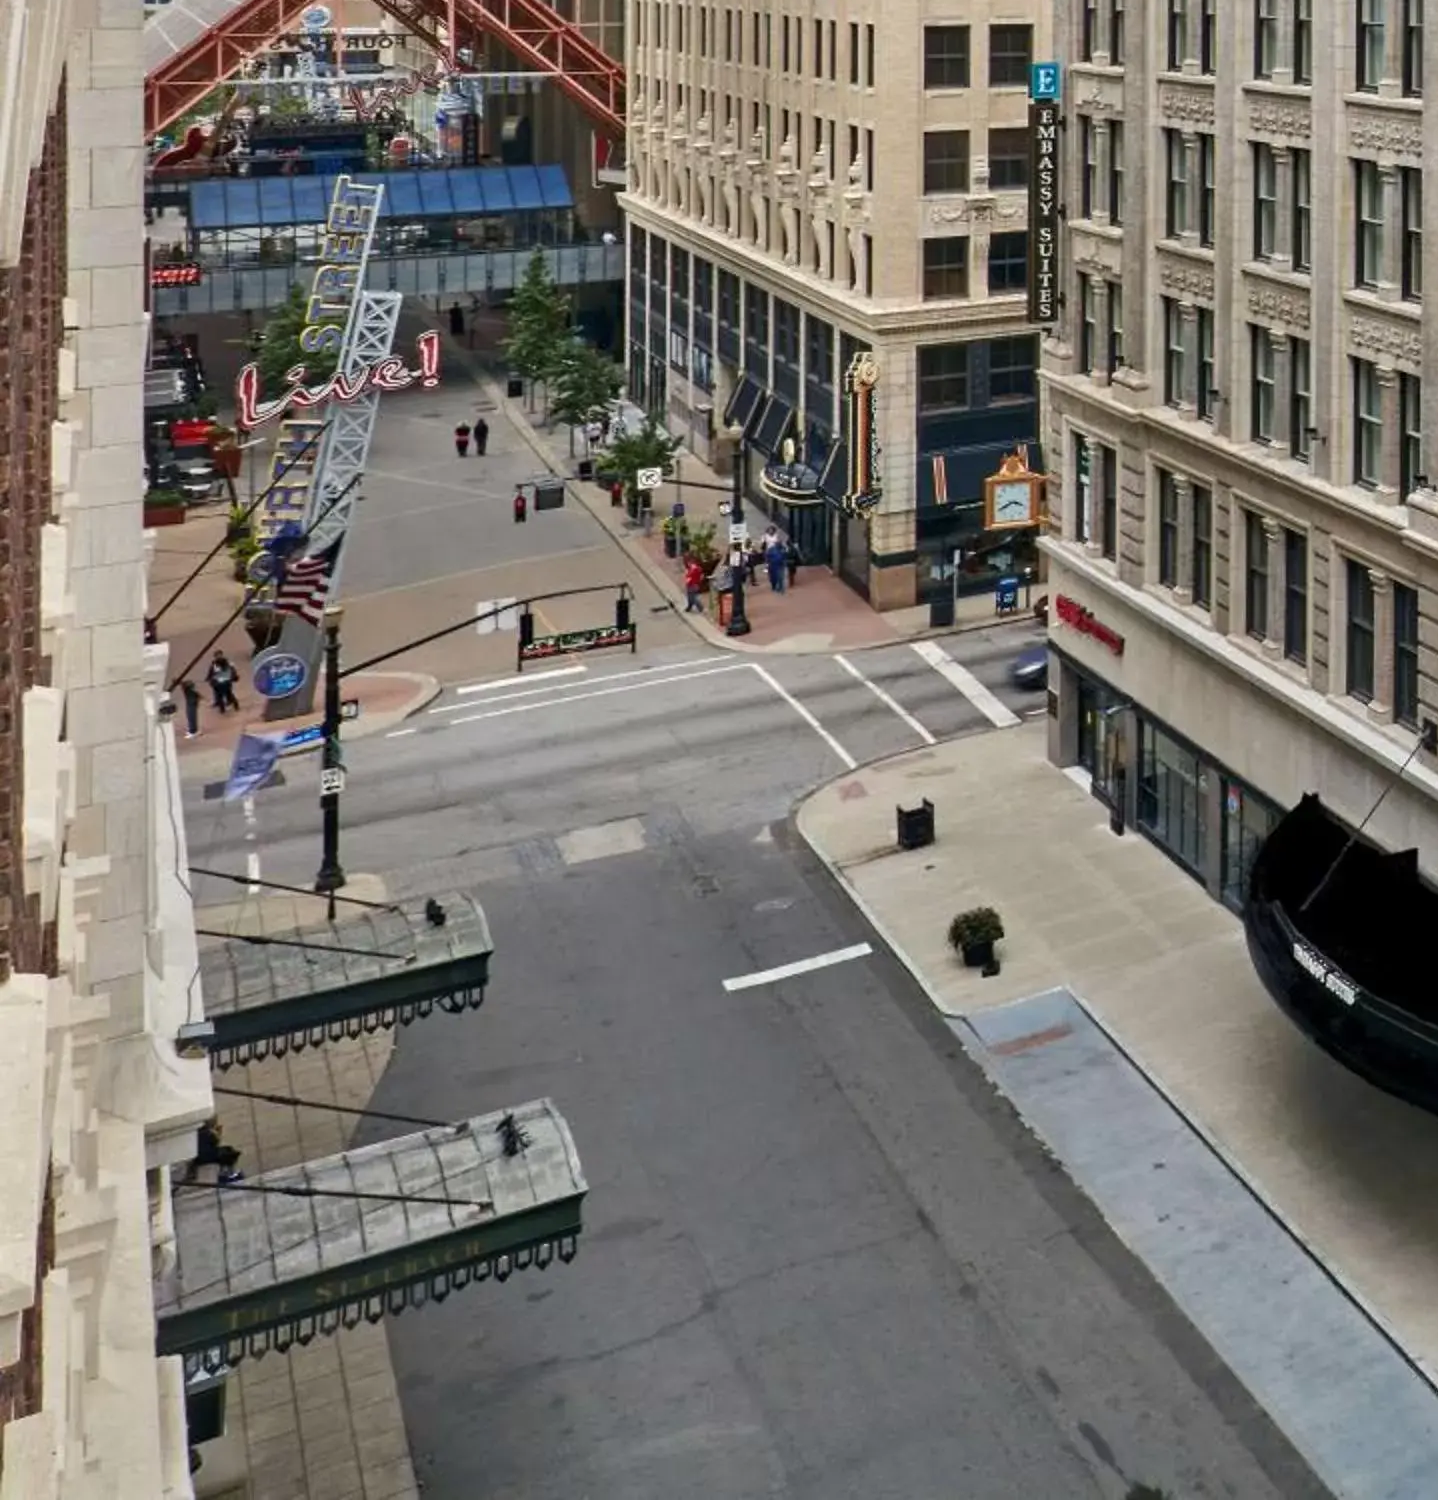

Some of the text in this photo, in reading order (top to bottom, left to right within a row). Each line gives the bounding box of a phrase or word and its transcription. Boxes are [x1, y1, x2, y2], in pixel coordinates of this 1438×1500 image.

[1037, 67, 1055, 94] E
[301, 176, 376, 352] STREET
[1037, 108, 1057, 318] EMBASSY SUITES
[238, 329, 440, 430] Live!
